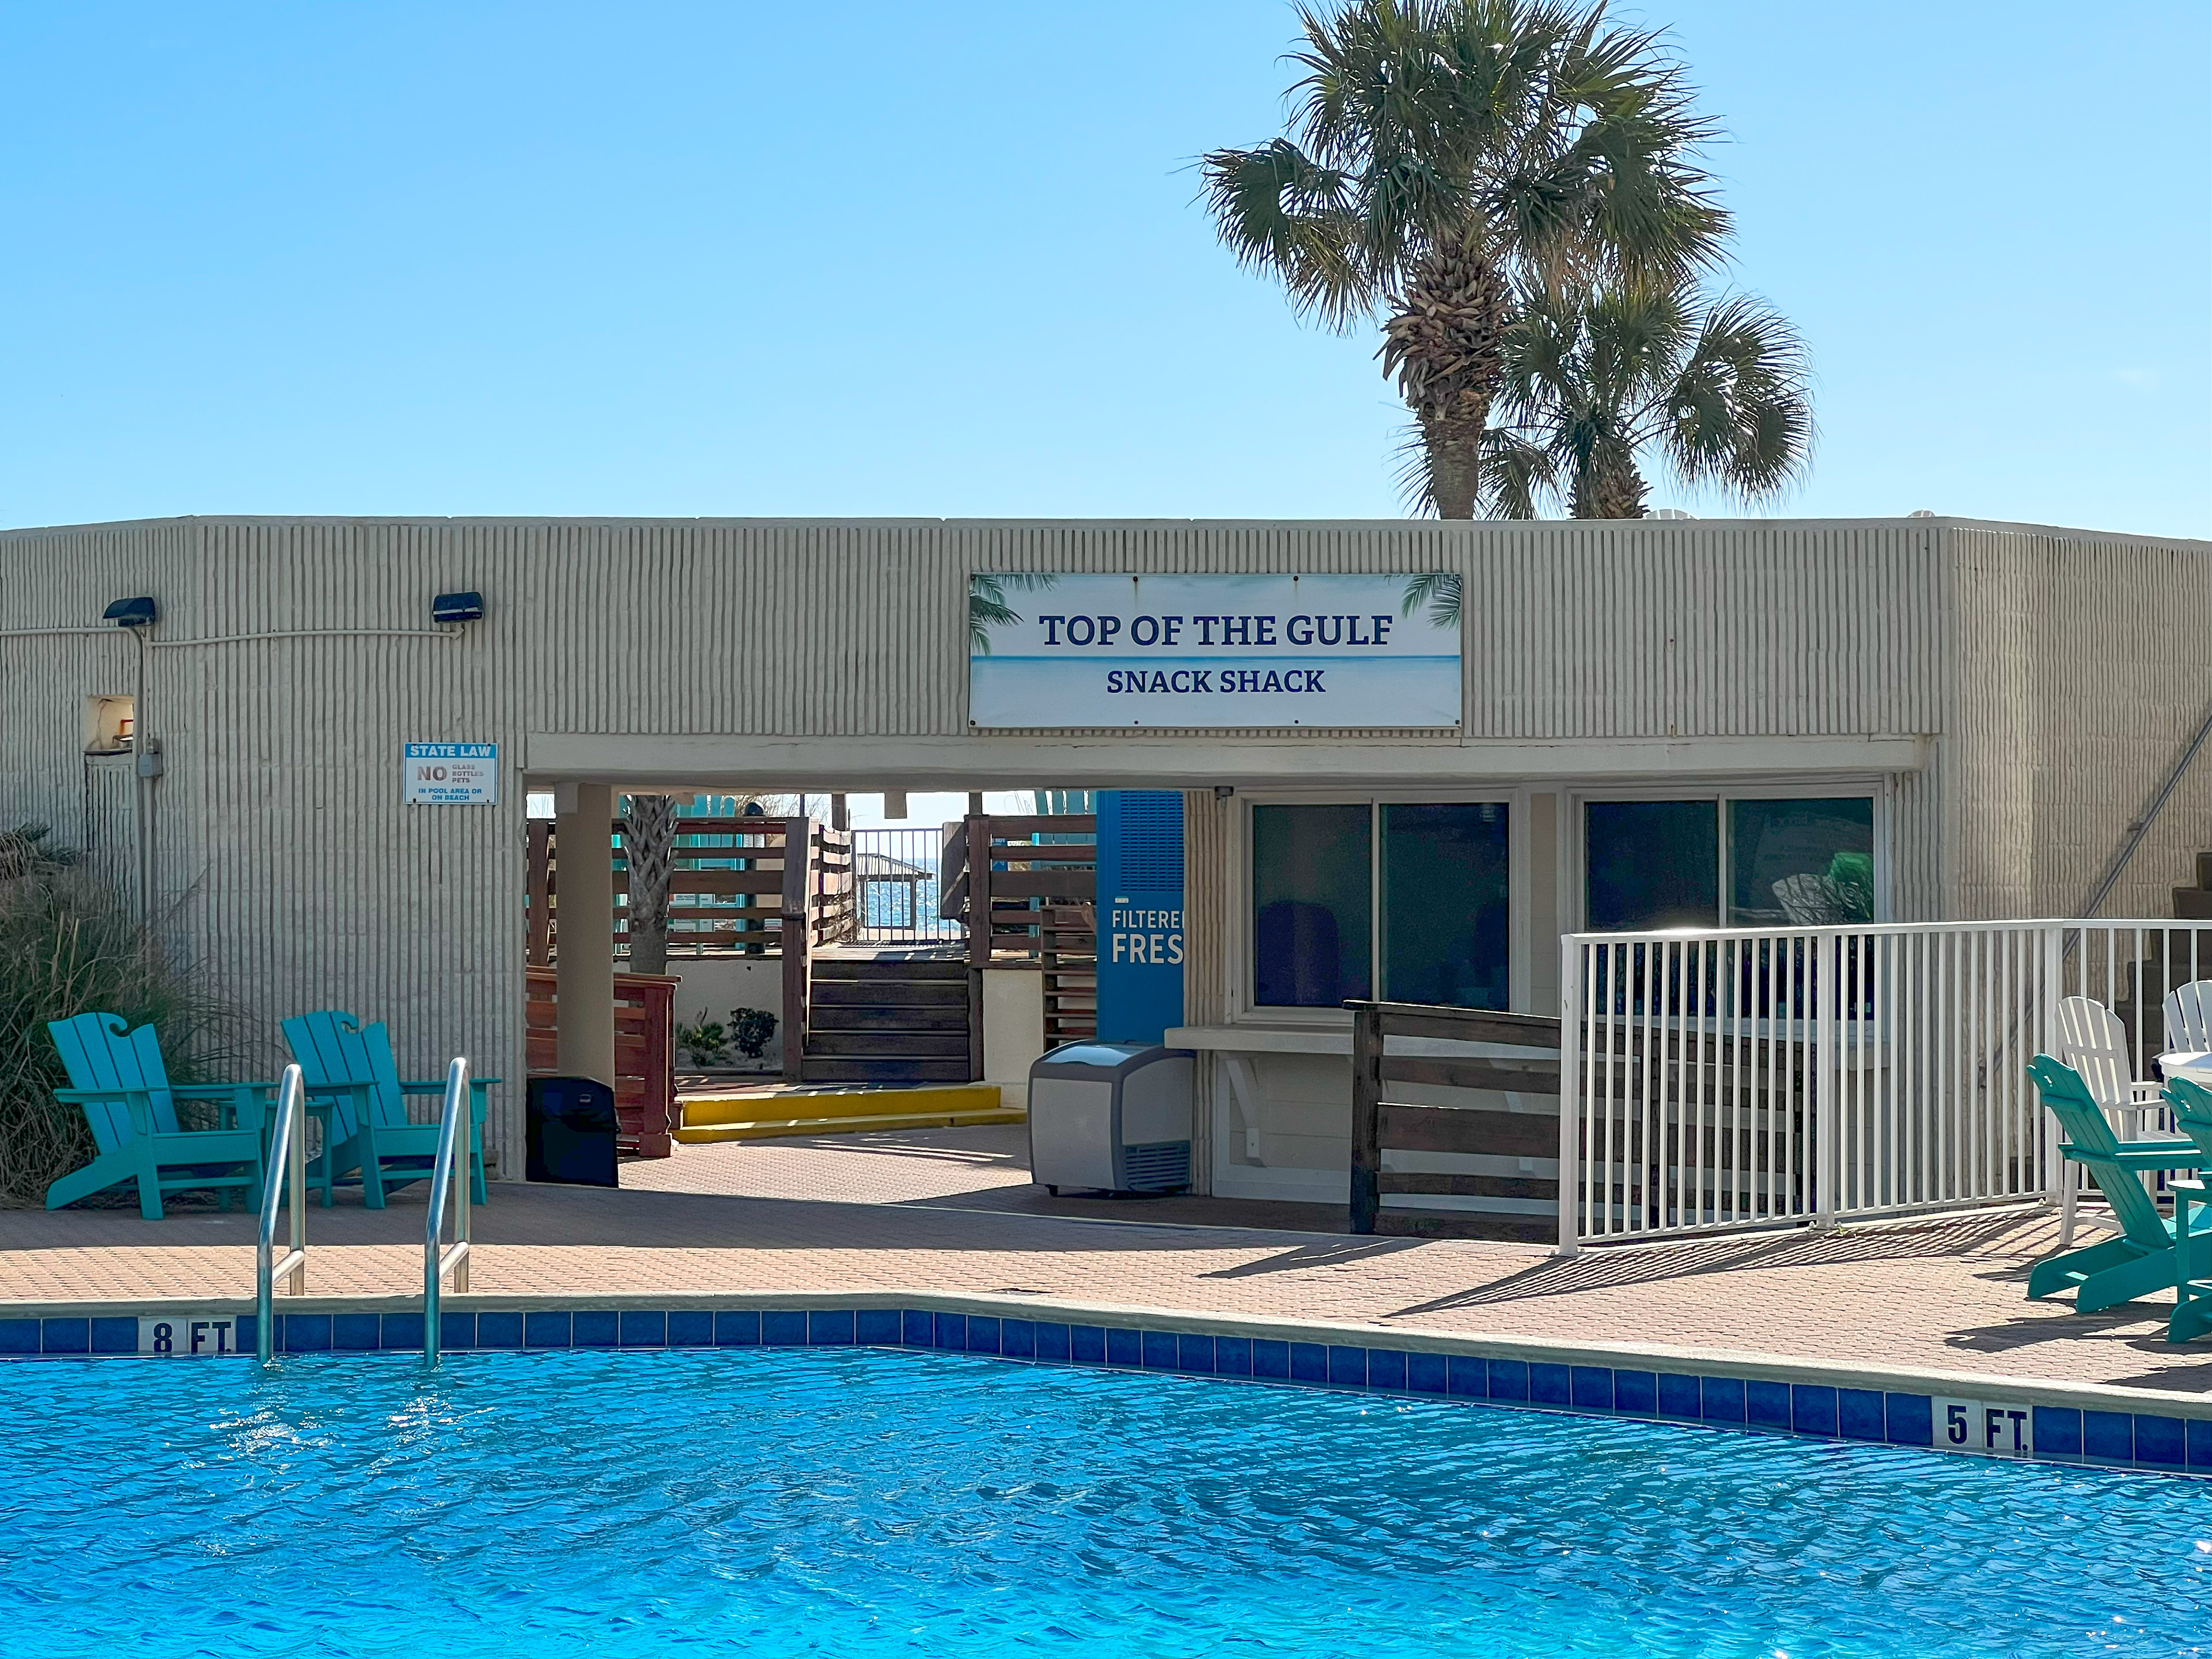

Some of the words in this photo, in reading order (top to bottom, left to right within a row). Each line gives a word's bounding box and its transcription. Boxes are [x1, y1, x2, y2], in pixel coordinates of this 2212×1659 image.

[1039, 615, 1122, 646] TOP
[1130, 615, 1183, 646] OF
[1193, 615, 1277, 646] THE
[1286, 615, 1393, 646] GULF
[1107, 670, 1214, 694] SNACK
[1219, 670, 1326, 694] SHACK
[410, 745, 456, 756] STATE
[460, 745, 491, 757] LAW
[417, 766, 448, 781] NO
[1112, 910, 1184, 929] FILTERE
[1112, 933, 1184, 964] FRES
[153, 1322, 172, 1353] 8
[191, 1321, 232, 1355] FT.
[1947, 1404, 1967, 1444] 5
[1986, 1408, 2028, 1451] FT.
